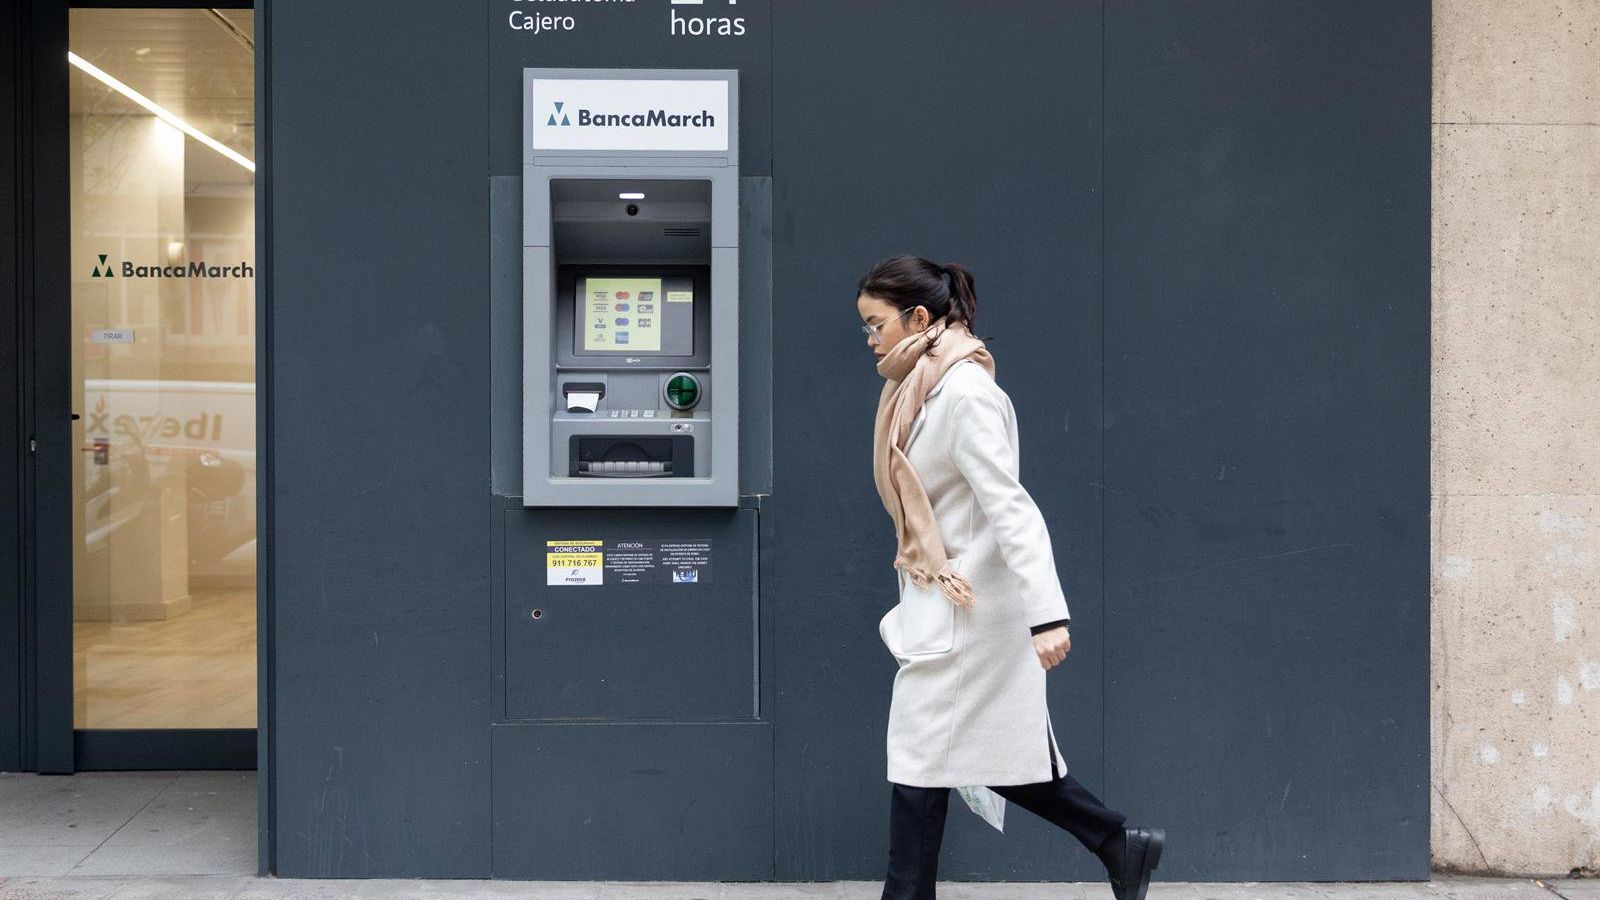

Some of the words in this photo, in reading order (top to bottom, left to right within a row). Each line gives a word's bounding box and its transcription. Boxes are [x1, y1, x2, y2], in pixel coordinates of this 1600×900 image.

[509, 11, 575, 34] Cajero
[671, 9, 745, 35] horas
[578, 109, 715, 127] BancaMarch
[122, 261, 254, 278] BancaMarch
[103, 332, 123, 340] TIRAR
